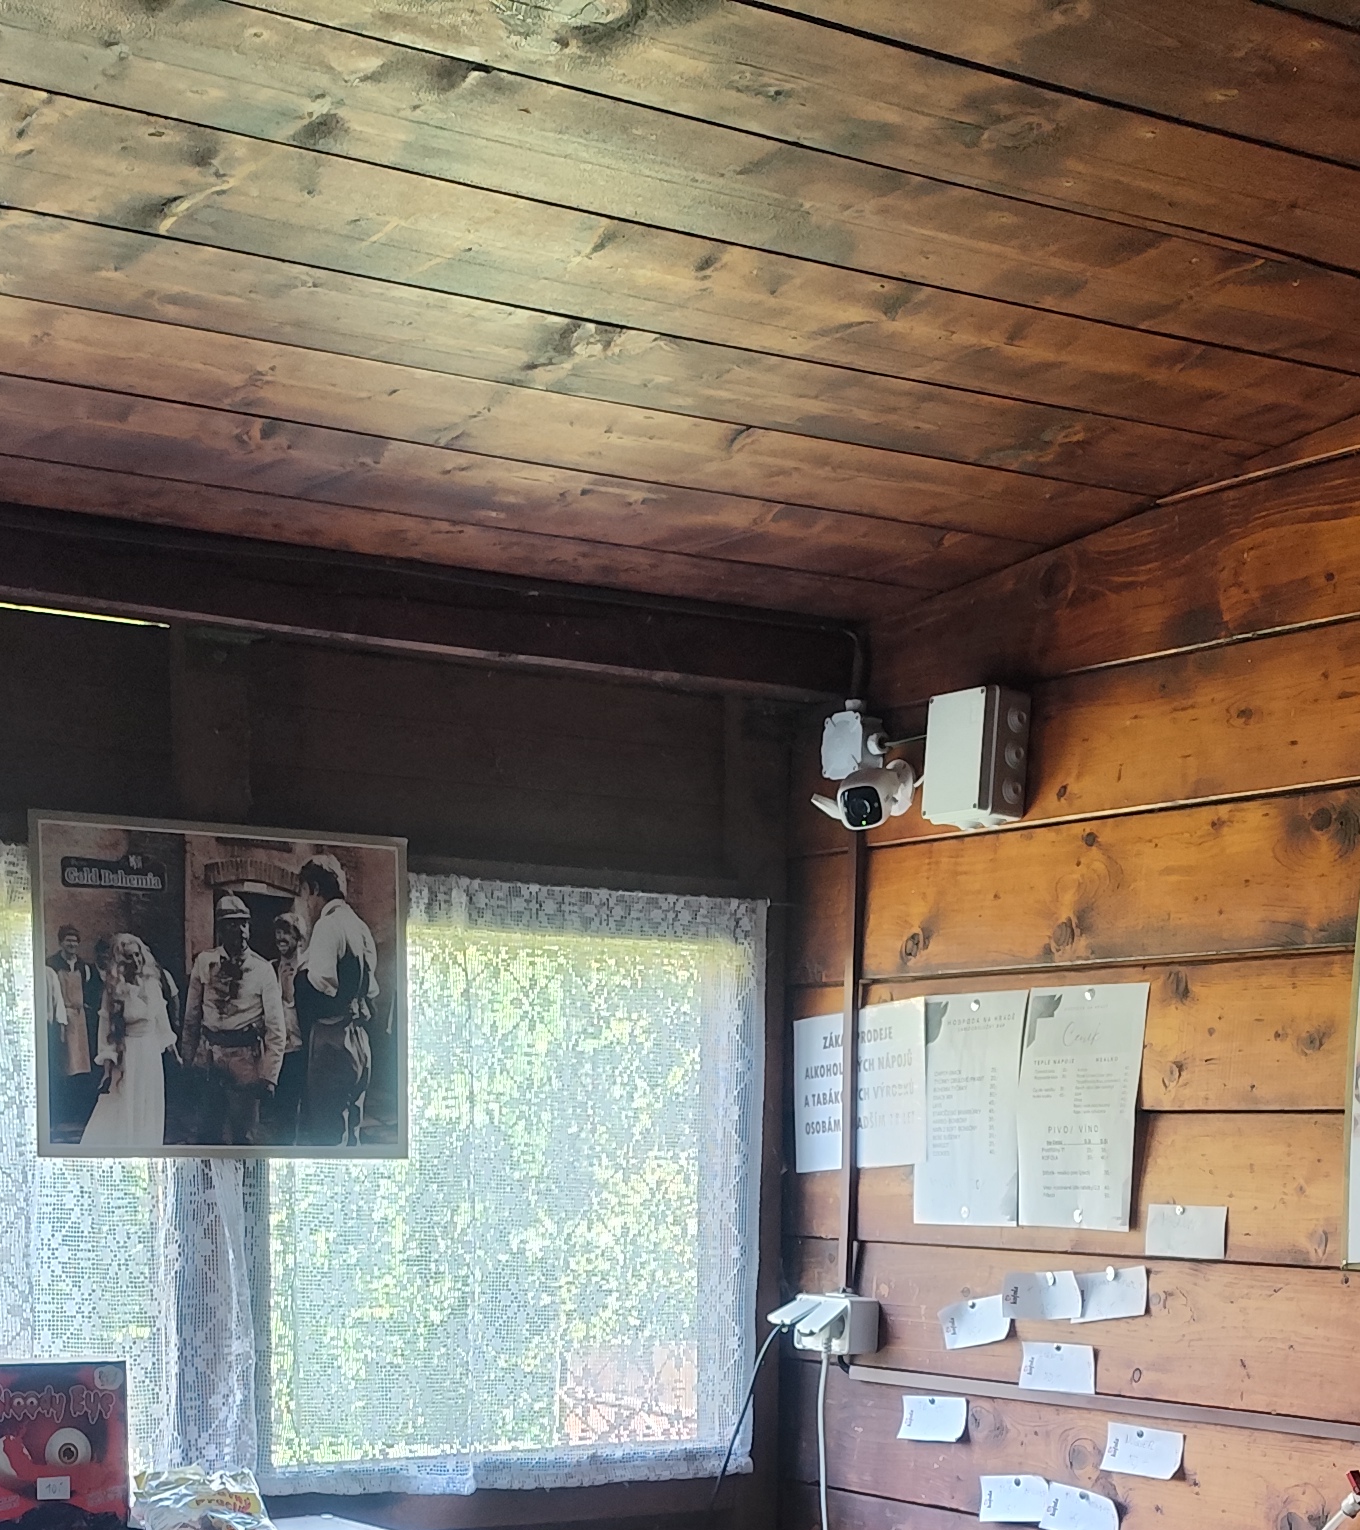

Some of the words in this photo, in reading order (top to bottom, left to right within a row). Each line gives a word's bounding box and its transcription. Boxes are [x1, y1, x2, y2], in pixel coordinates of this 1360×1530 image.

[64, 867, 101, 885] Gold
[100, 869, 162, 889] Bohemia
[805, 1115, 842, 1136] OSOBÁM
